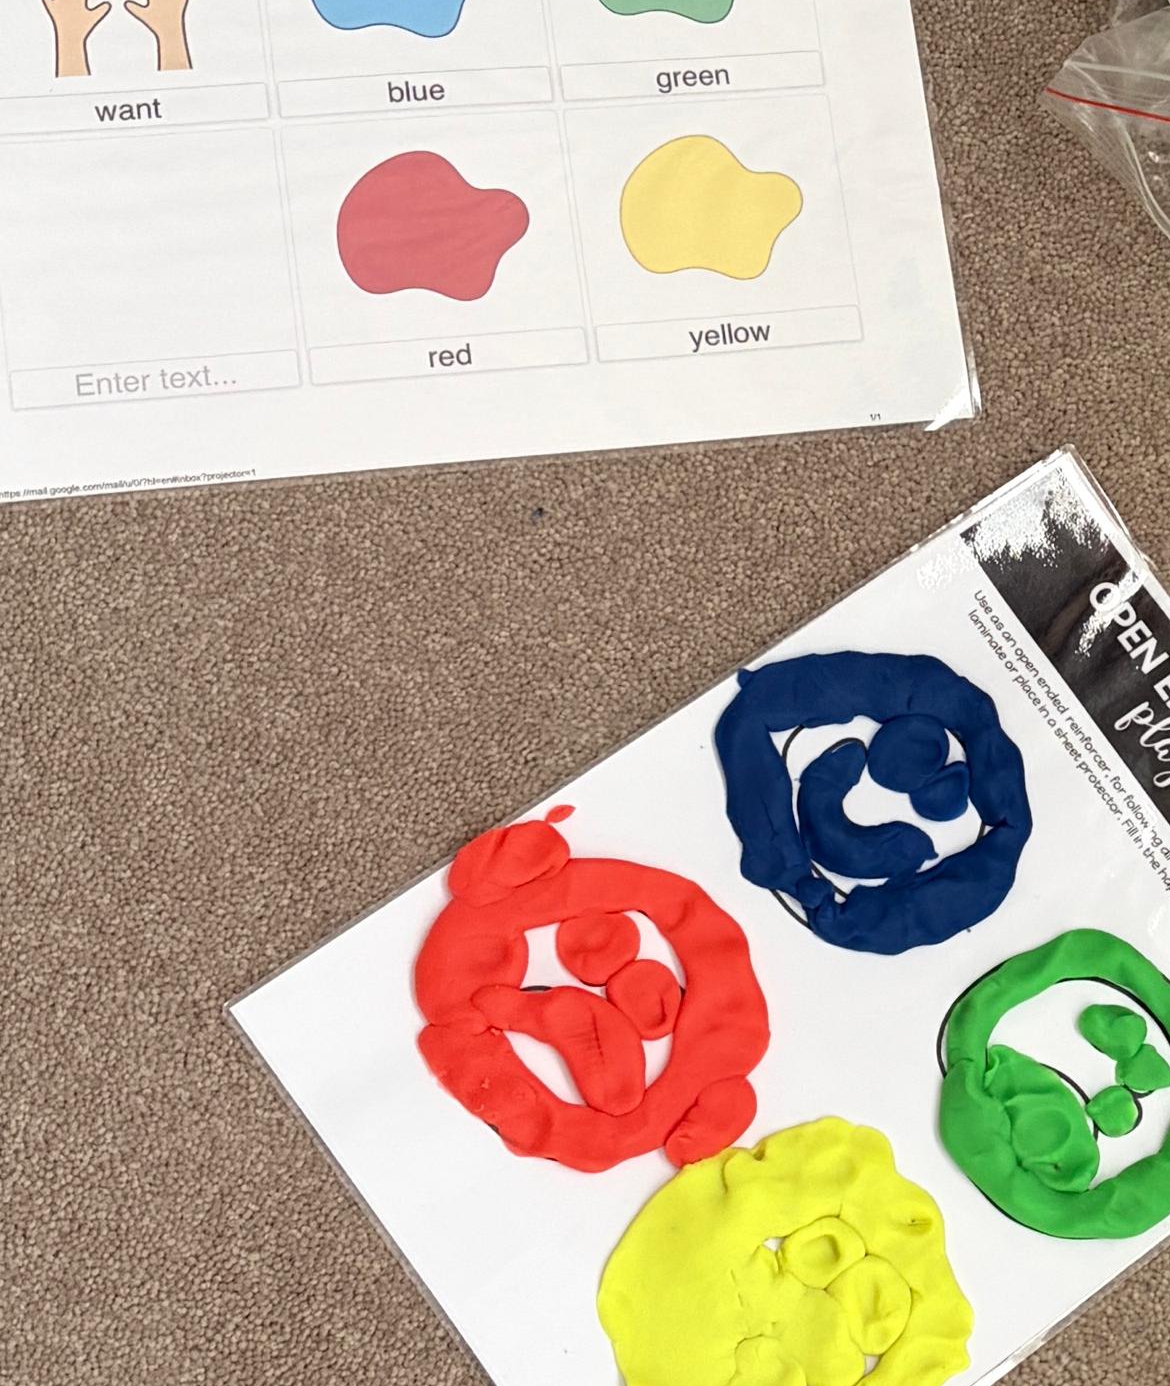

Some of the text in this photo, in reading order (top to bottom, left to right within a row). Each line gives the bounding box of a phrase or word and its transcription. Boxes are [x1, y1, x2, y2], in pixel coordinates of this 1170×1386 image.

[387, 79, 445, 103] blue
[656, 68, 730, 94] green
[94, 98, 162, 124] want
[689, 320, 770, 349] yellow
[429, 343, 472, 367] red
[75, 366, 237, 397] Enter text...
[1089, 582, 1170, 675] OPEN
[974, 590, 993, 615] Use
[990, 615, 1005, 631] as
[1001, 631, 1017, 648] an
[1014, 647, 1039, 678] open
[1036, 677, 1070, 715] ended
[1065, 716, 1111, 778] reinforcer,
[1109, 775, 1127, 793] for
[1123, 794, 1163, 848] followng
[968, 609, 1007, 661] laminate
[1004, 660, 1019, 673] or
[1012, 674, 1041, 707] place
[1038, 705, 1050, 718] in
[1047, 718, 1057, 728] a
[1054, 727, 1082, 762] sheet
[1075, 761, 1123, 820] protector.
[1121, 818, 1139, 837] Fill
[1132, 834, 1144, 850] in
[1142, 847, 1161, 870] the
